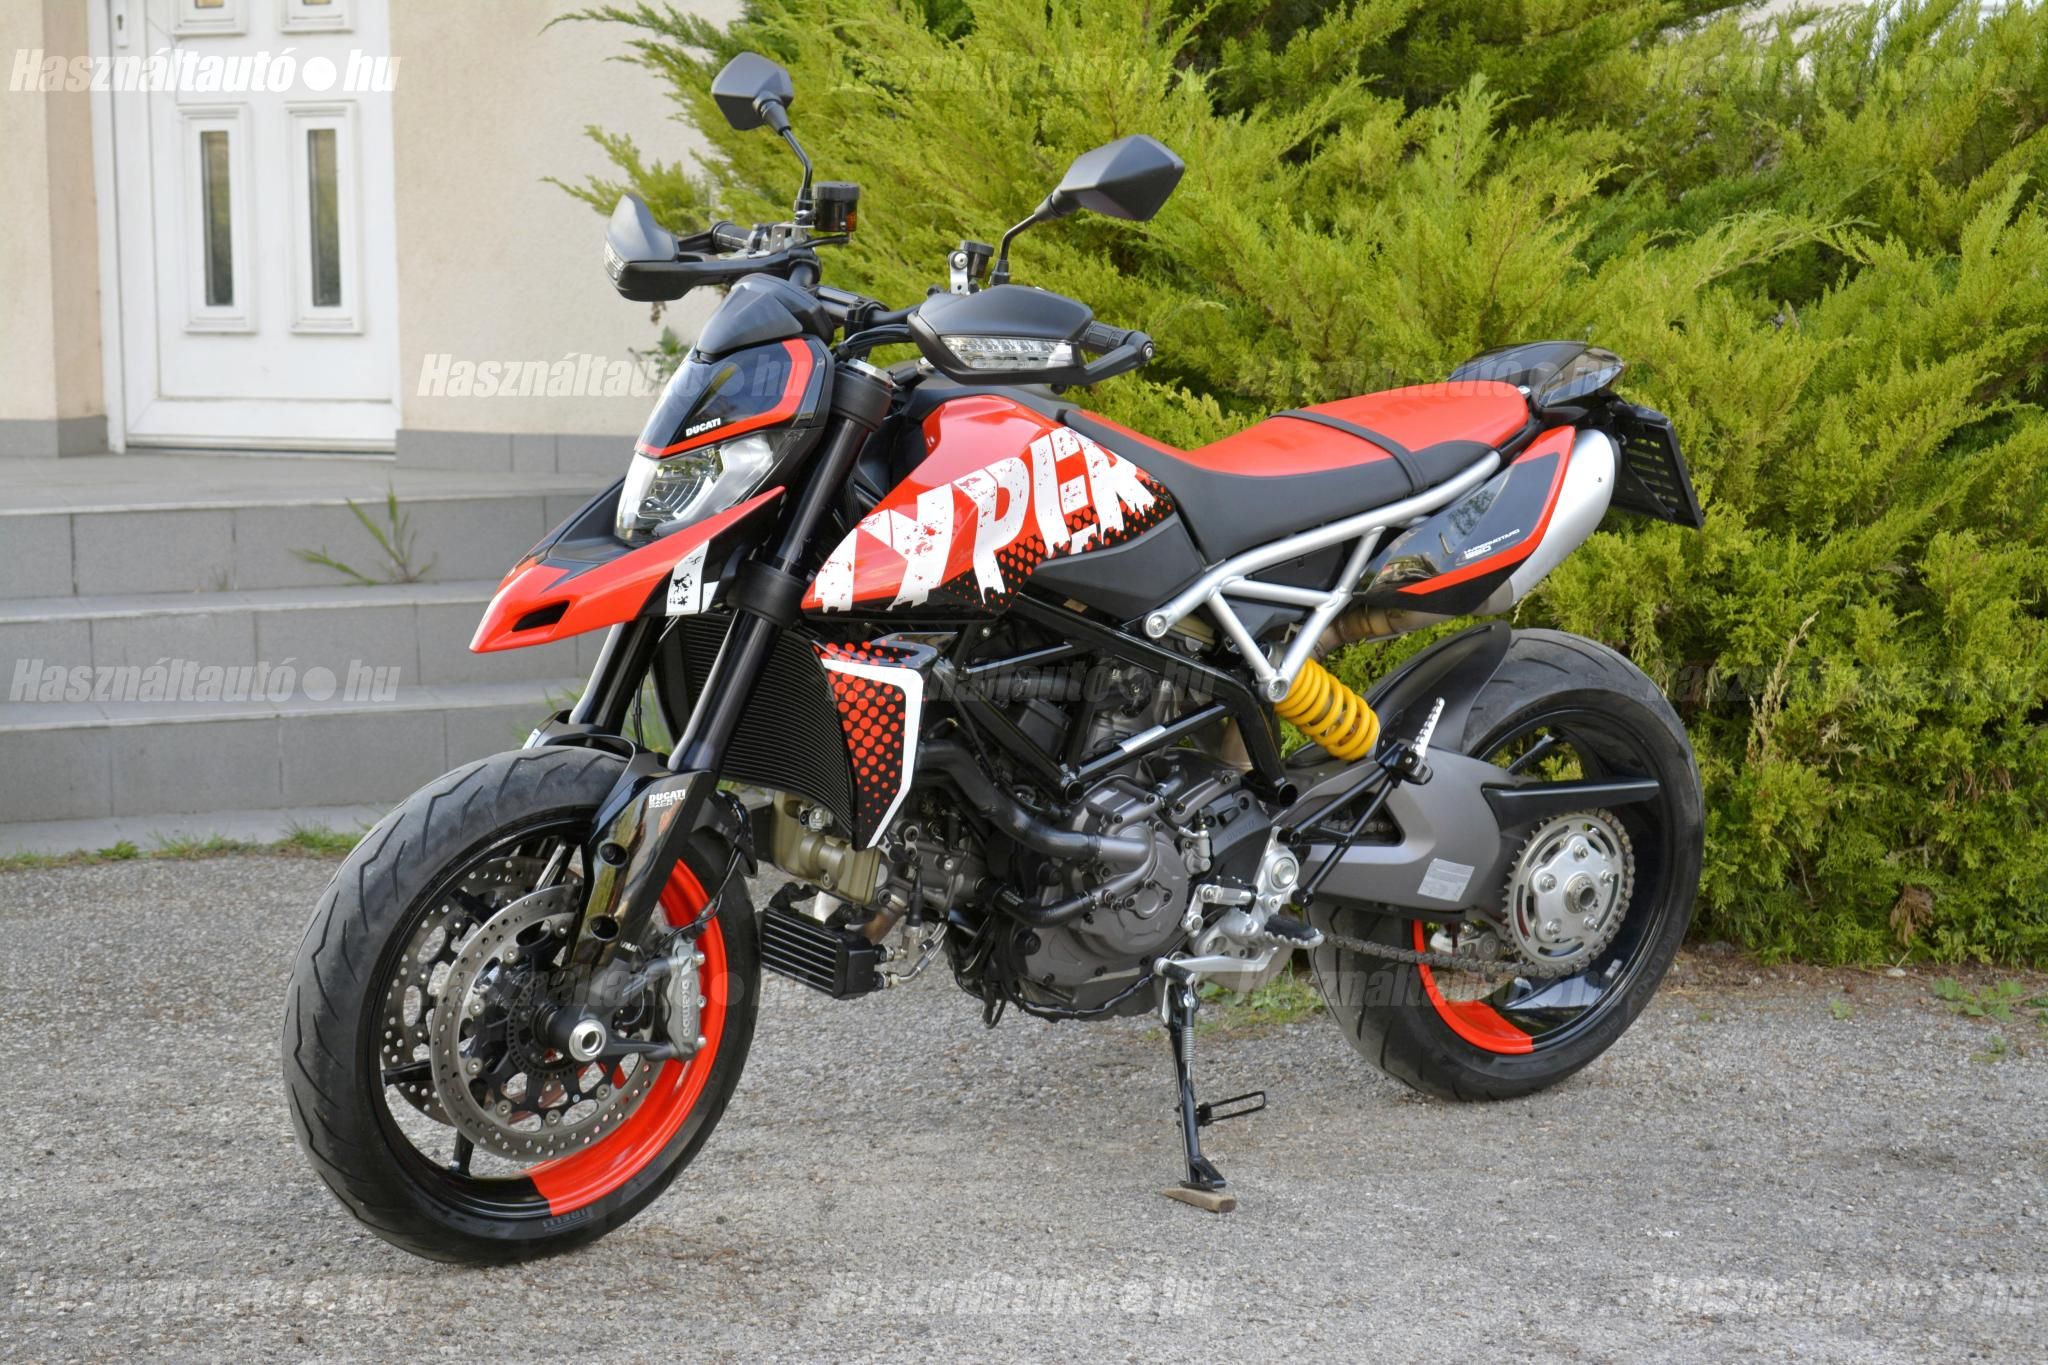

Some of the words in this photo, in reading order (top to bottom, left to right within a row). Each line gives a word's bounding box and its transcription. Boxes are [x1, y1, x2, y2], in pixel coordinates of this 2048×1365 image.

[686, 417, 721, 437] DUCATI
[649, 789, 686, 801] DUCATI
[681, 980, 691, 1037] brembo
